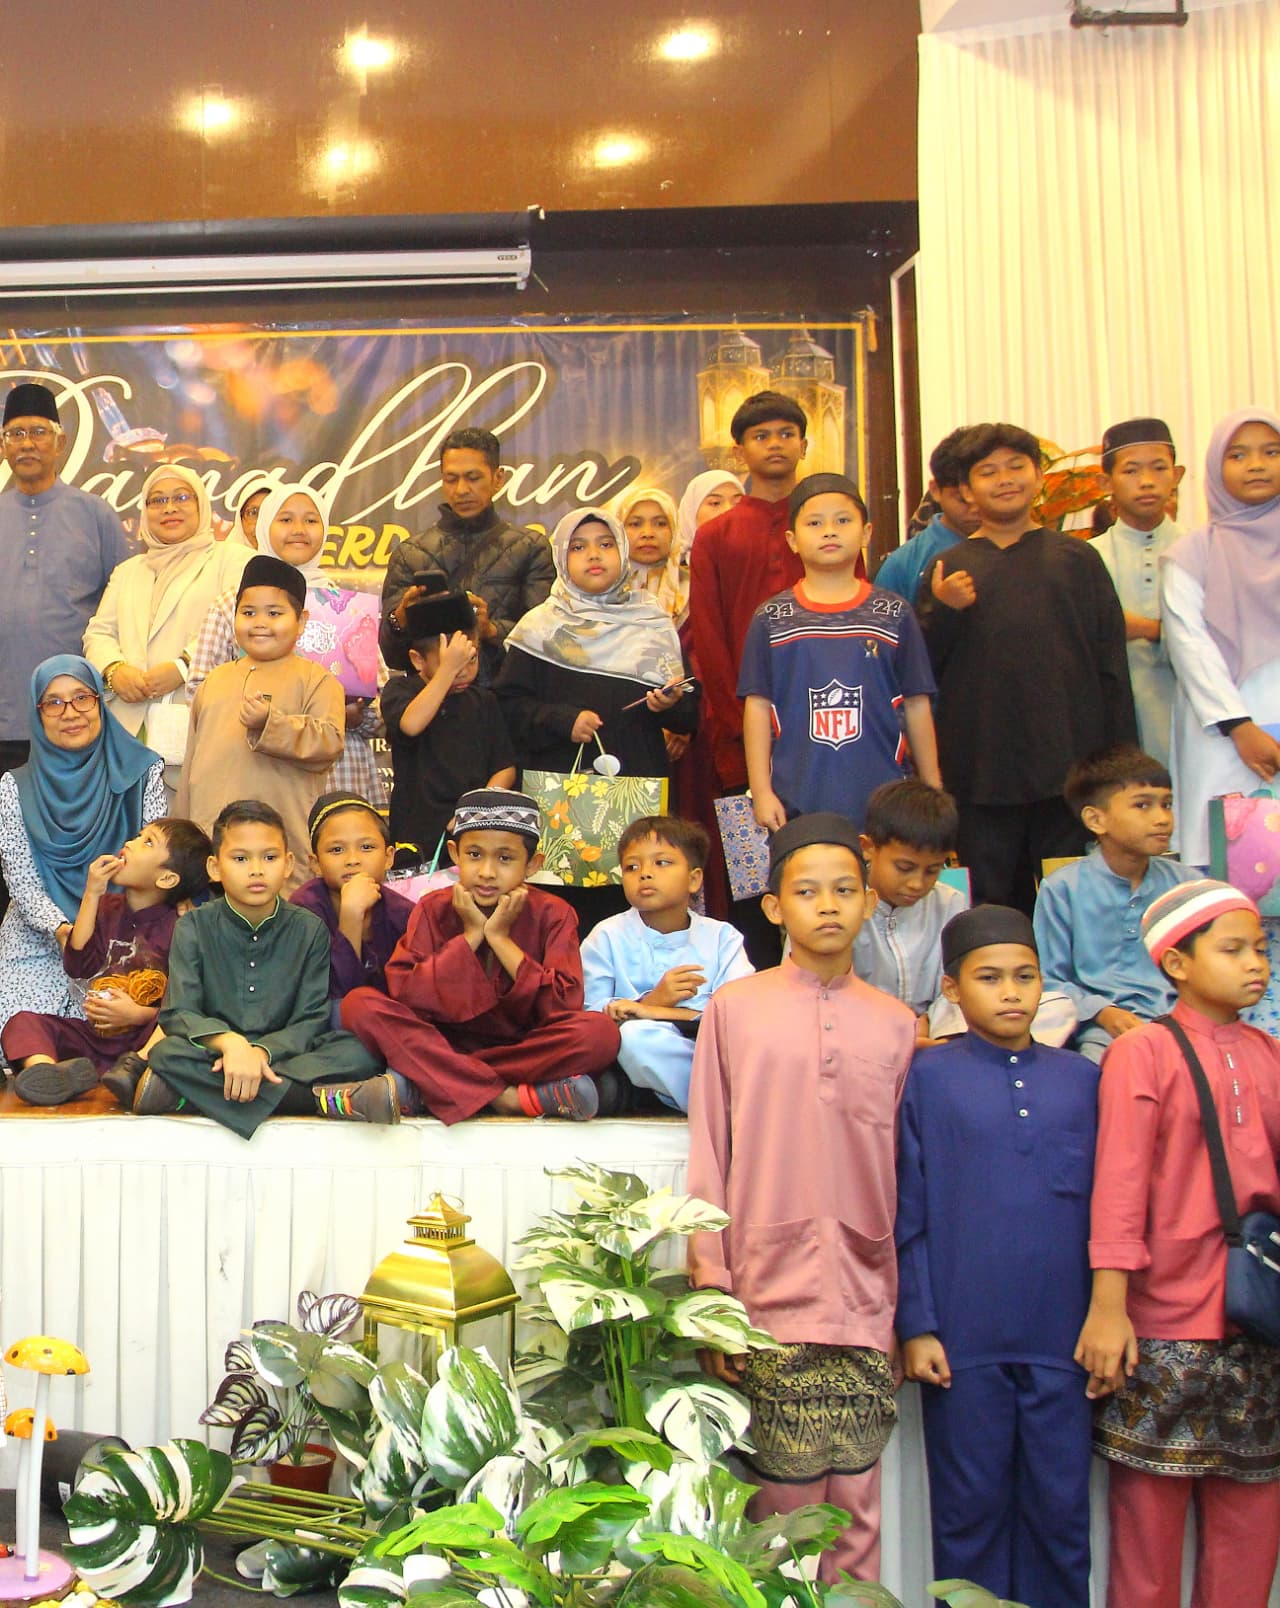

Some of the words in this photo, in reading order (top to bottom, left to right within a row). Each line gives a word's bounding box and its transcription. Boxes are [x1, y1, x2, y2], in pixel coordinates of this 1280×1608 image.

[765, 602, 794, 620] 24
[872, 599, 902, 617] 24
[815, 709, 856, 739] NFL
